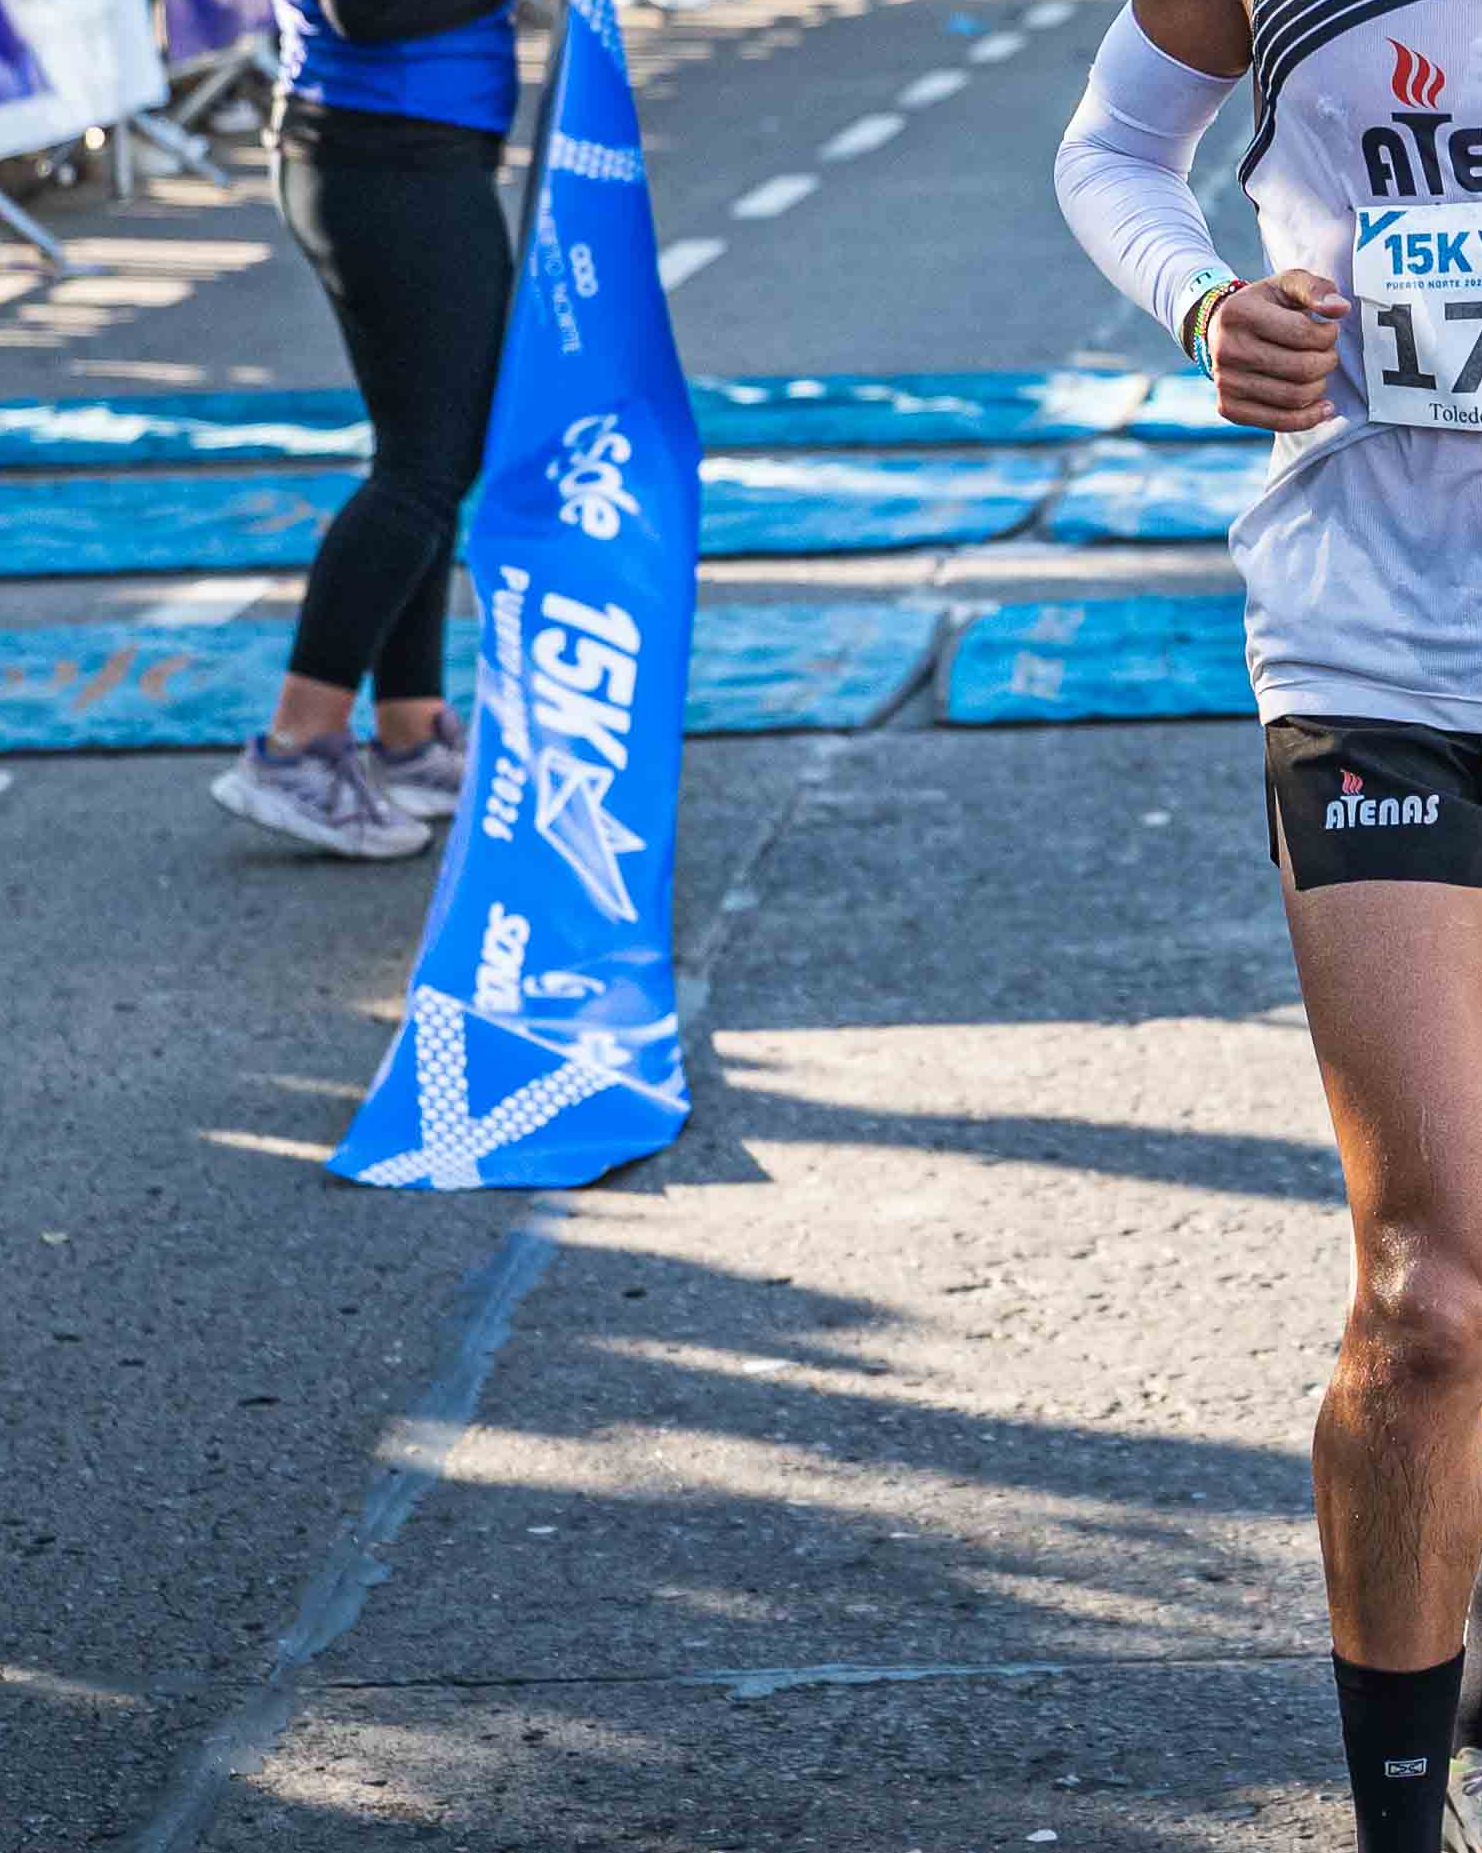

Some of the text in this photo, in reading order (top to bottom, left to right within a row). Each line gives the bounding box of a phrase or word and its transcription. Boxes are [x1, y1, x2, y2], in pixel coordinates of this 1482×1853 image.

[1384, 231, 1472, 275] 15K
[1385, 279, 1424, 290] PUERTO
[1428, 278, 1461, 289] NORTE
[532, 592, 641, 772] 15K
[1325, 794, 1440, 830] ATENAS
